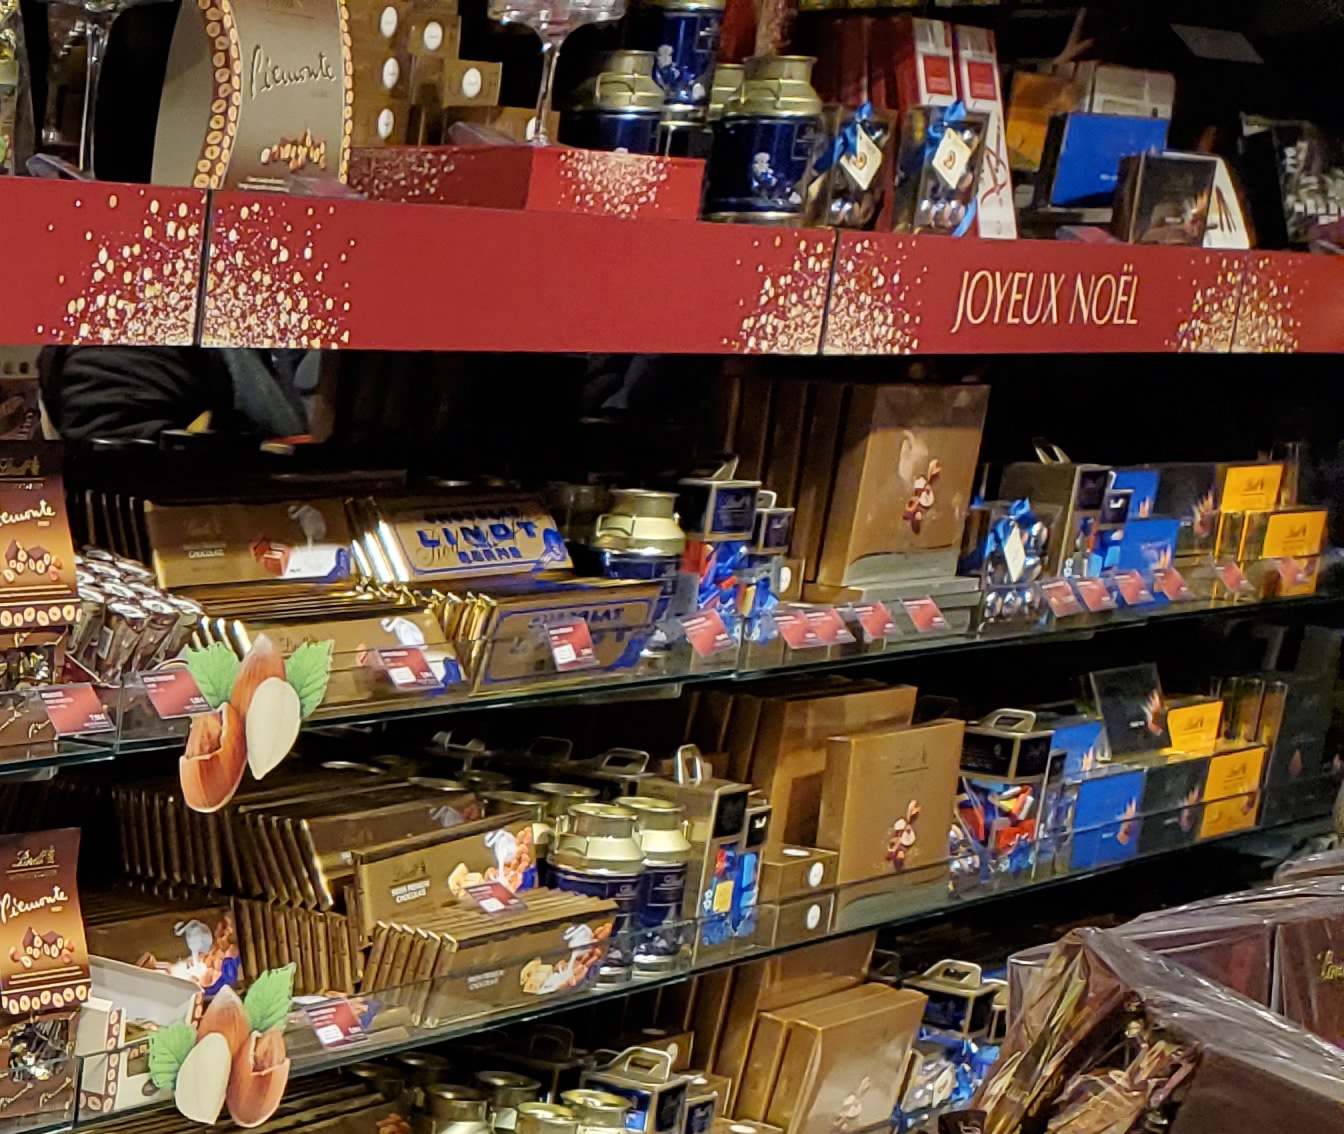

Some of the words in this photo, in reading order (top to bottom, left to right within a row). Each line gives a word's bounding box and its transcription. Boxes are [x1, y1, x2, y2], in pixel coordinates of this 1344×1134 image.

[249, 44, 338, 100] Piemonte
[952, 268, 1062, 332] JOYEUX
[1068, 263, 1140, 326] NOËL
